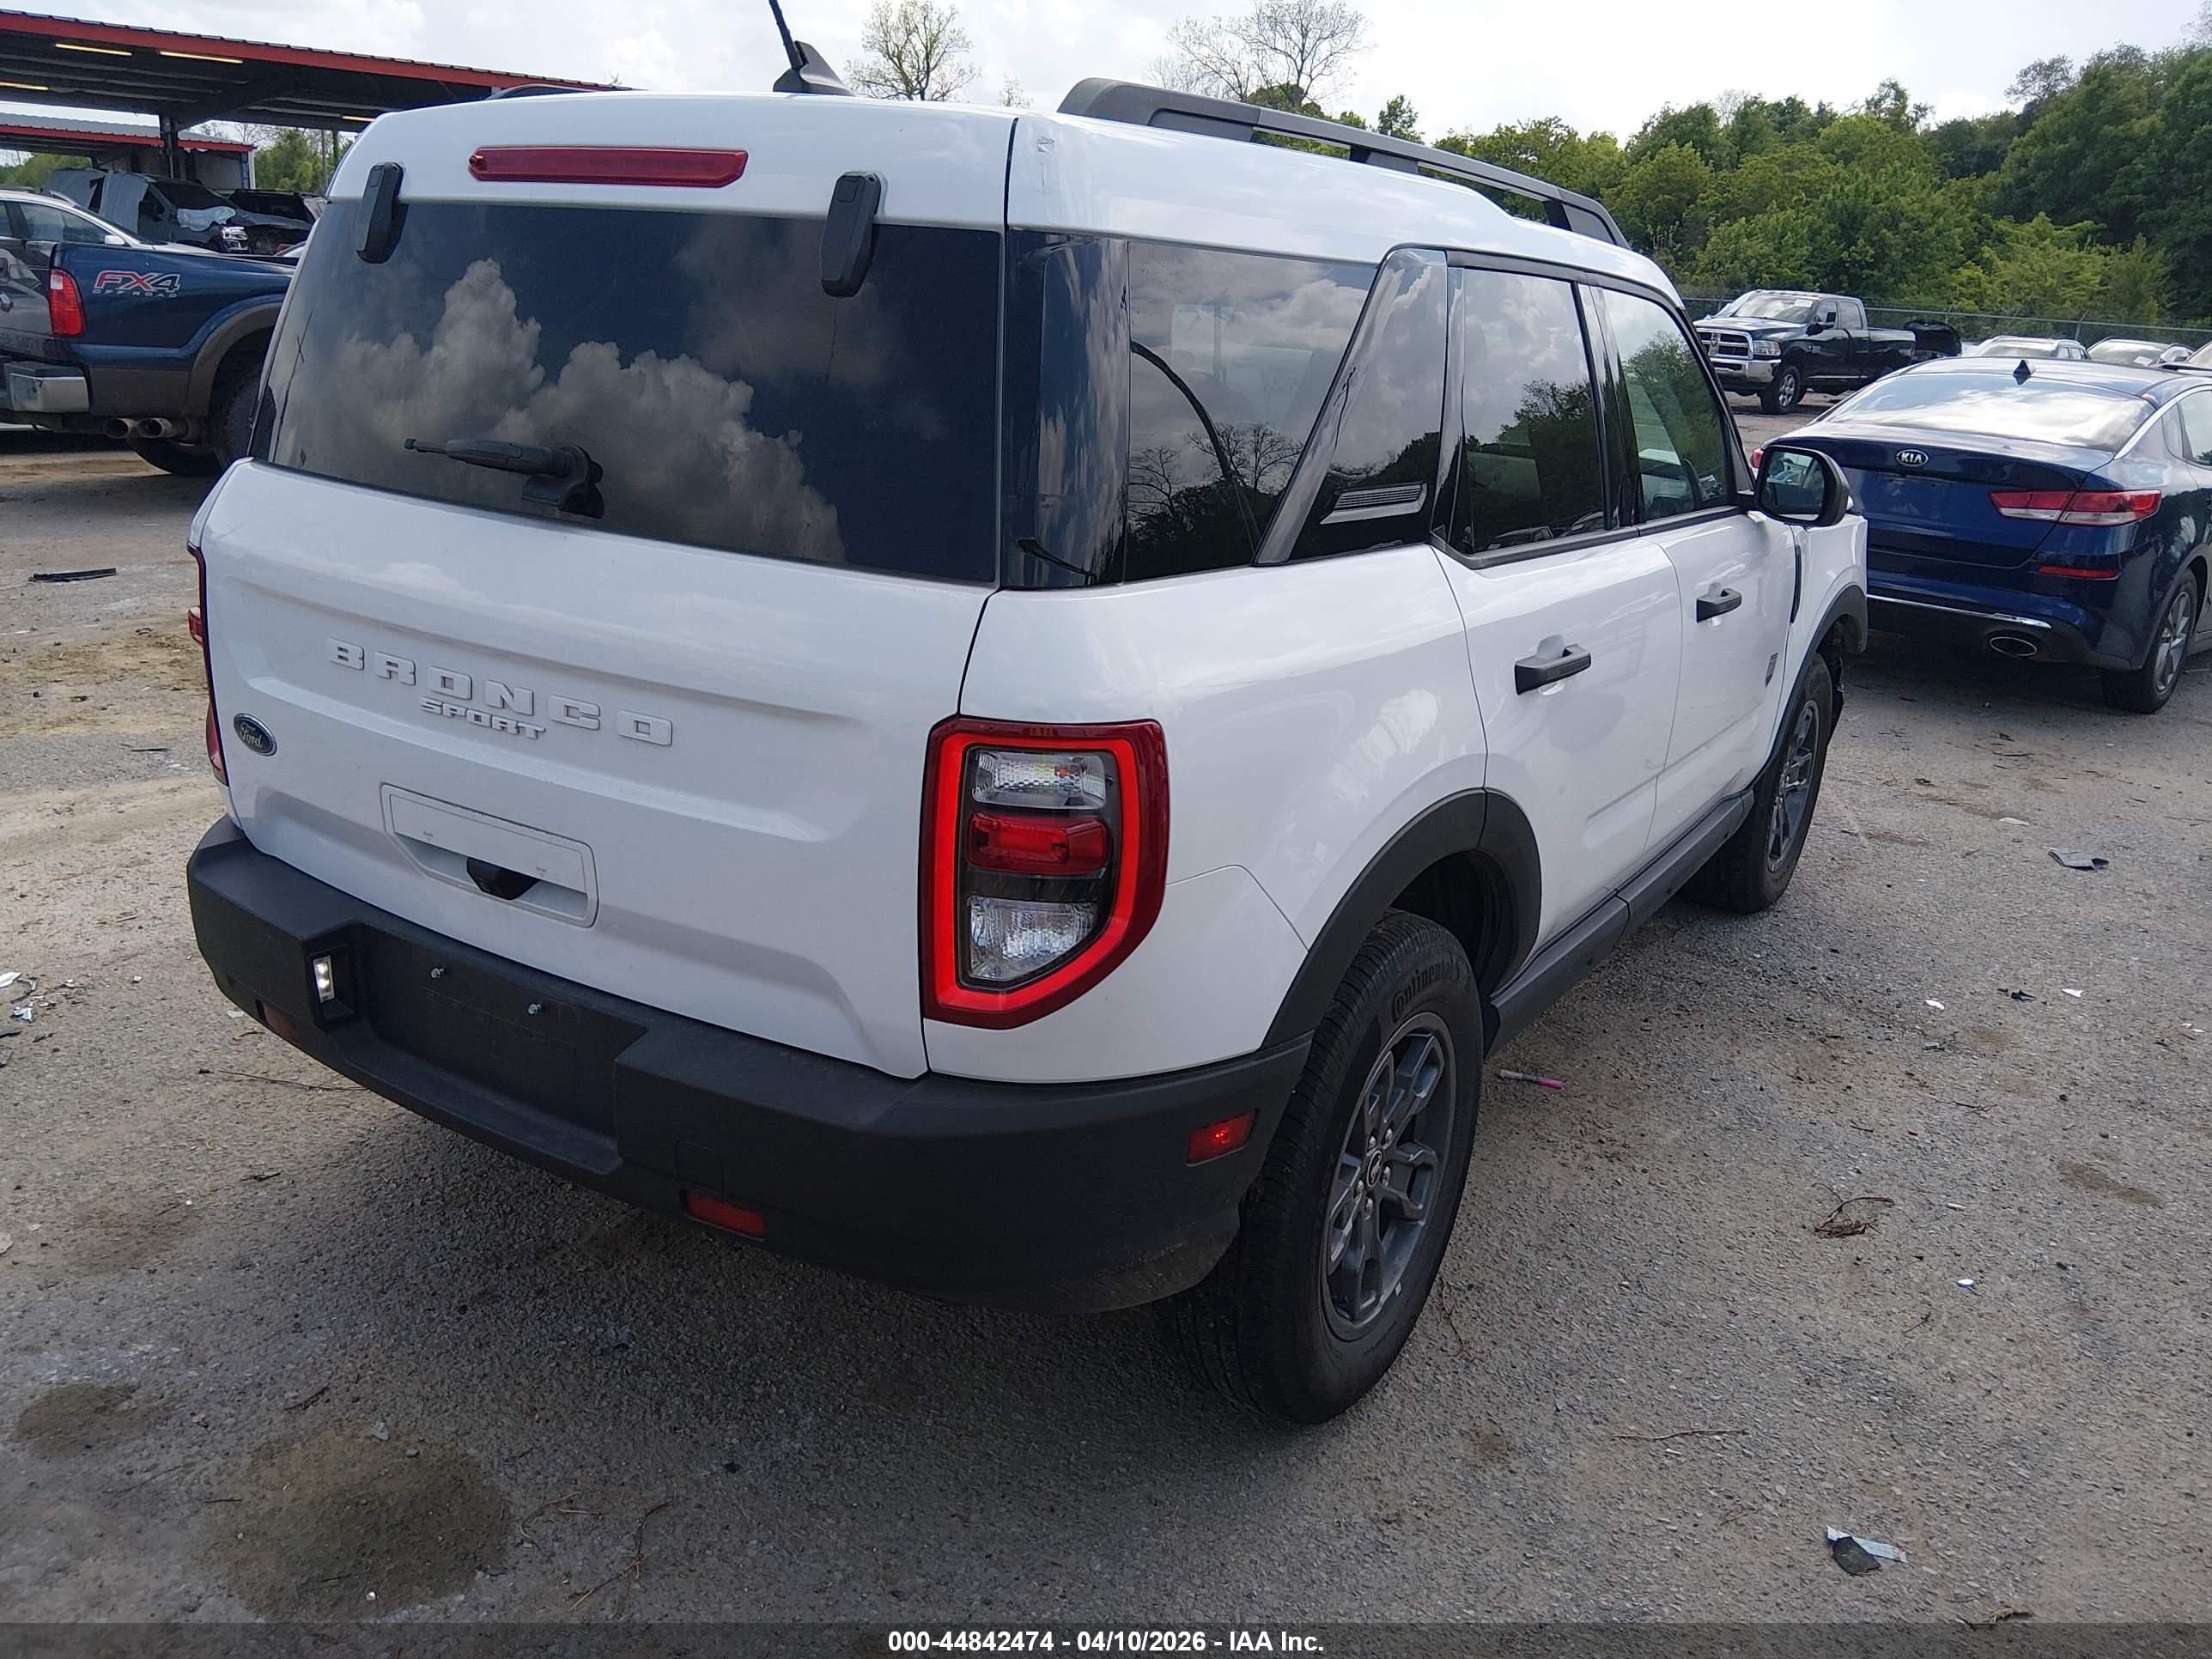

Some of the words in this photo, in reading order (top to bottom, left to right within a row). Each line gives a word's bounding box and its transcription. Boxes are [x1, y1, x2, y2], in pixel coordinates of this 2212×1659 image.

[93, 269, 182, 293] FX4
[1901, 452, 1923, 464] KIA
[325, 638, 673, 746] BRONCO
[419, 696, 546, 740] SPORT
[1391, 954, 1455, 1023] Continental
